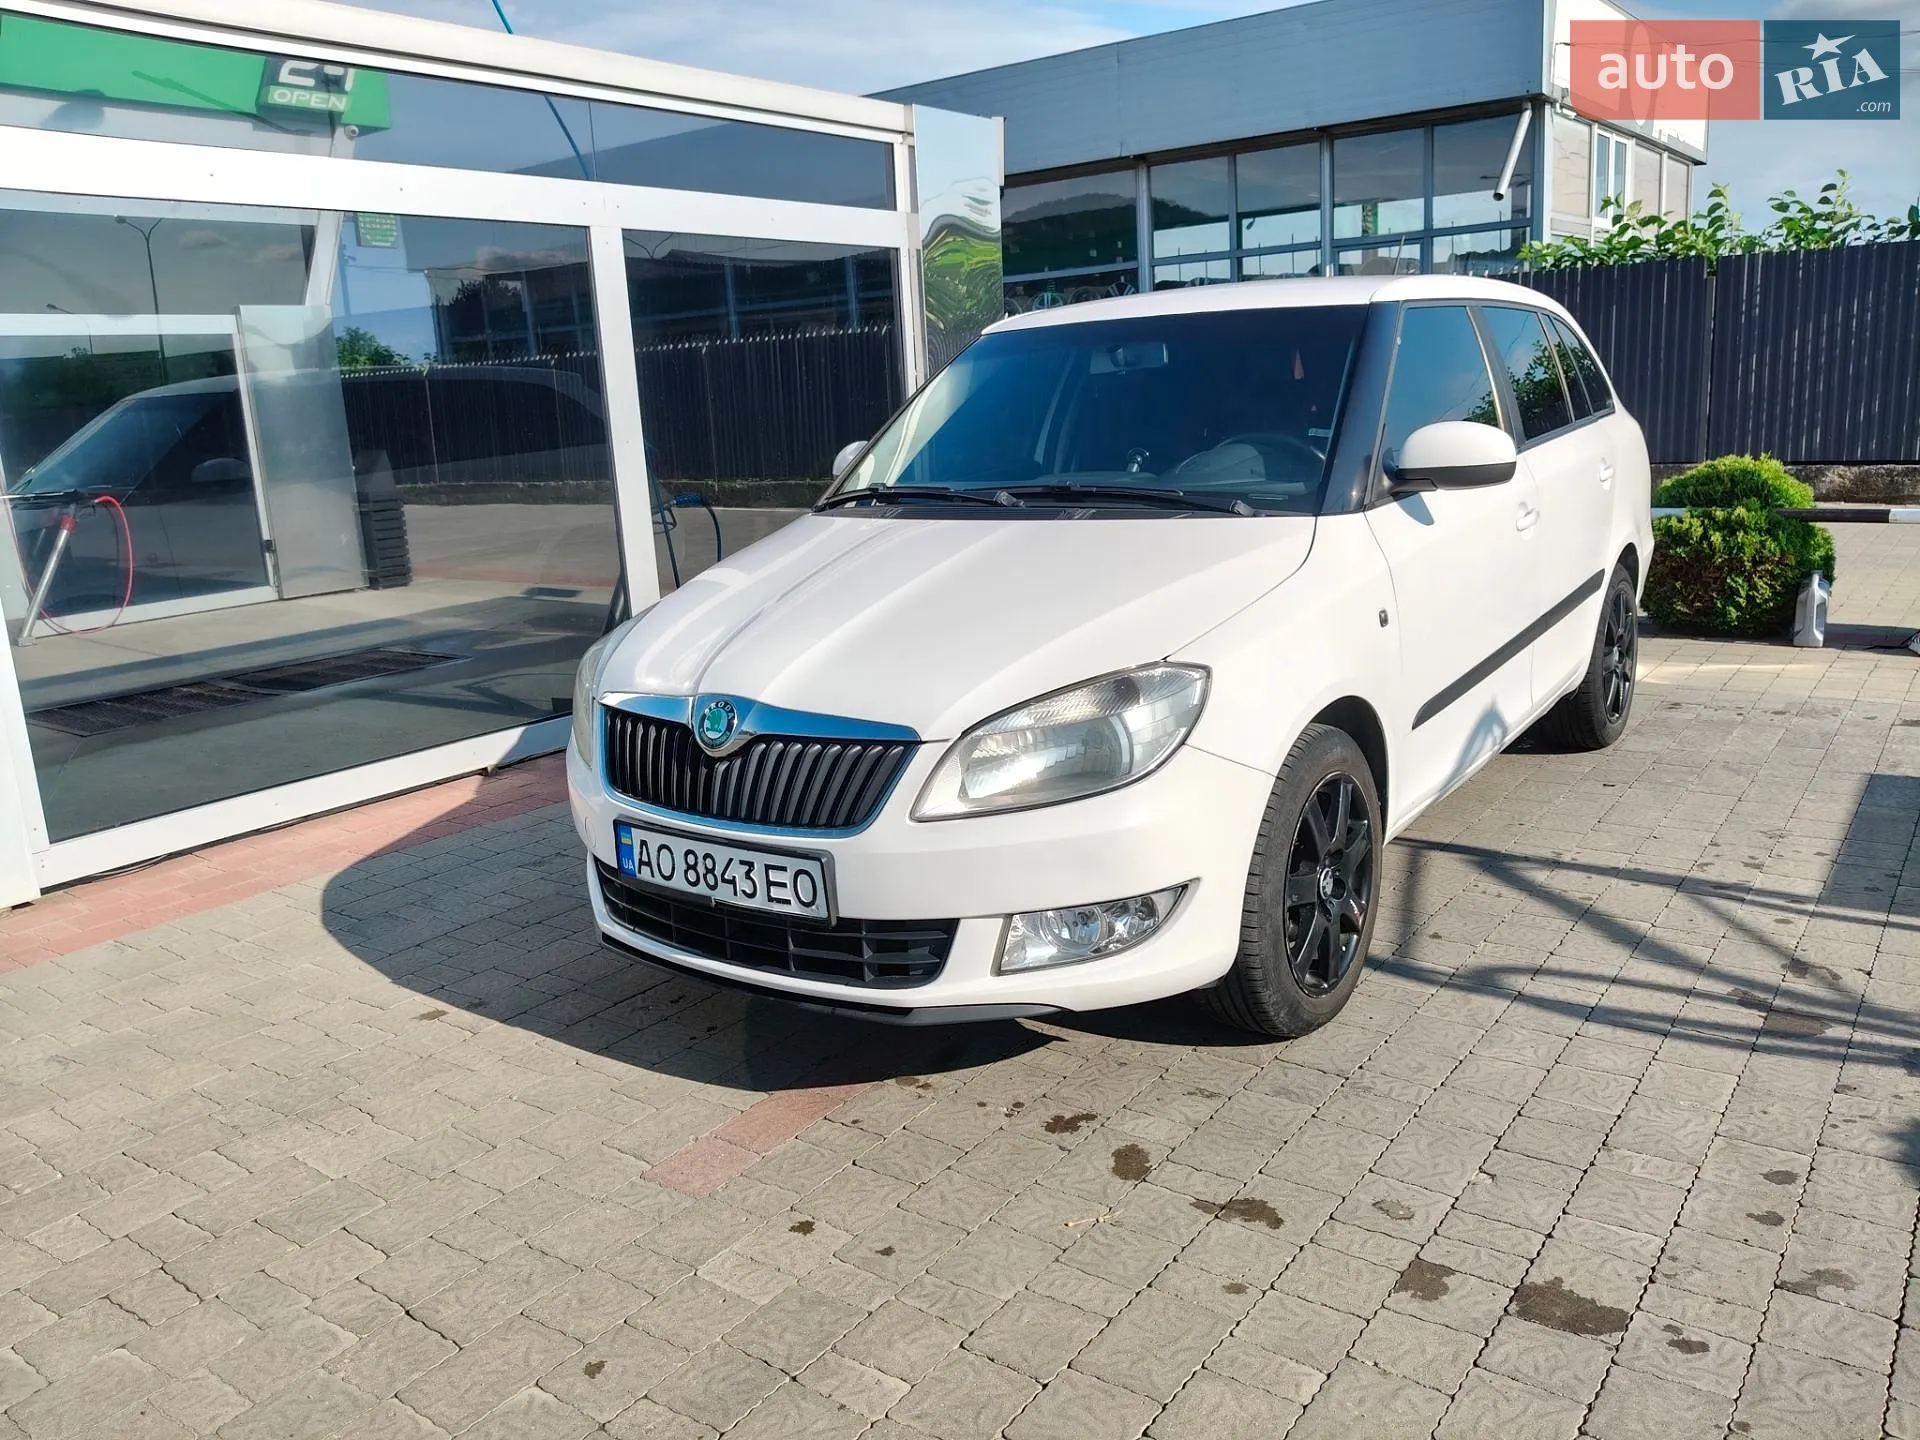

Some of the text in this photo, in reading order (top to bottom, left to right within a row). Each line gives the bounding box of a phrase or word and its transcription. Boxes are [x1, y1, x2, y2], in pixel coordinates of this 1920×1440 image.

[273, 88, 347, 112] OPEN
[622, 857, 635, 871] UA
[637, 839, 818, 908] AO 8843 EO
